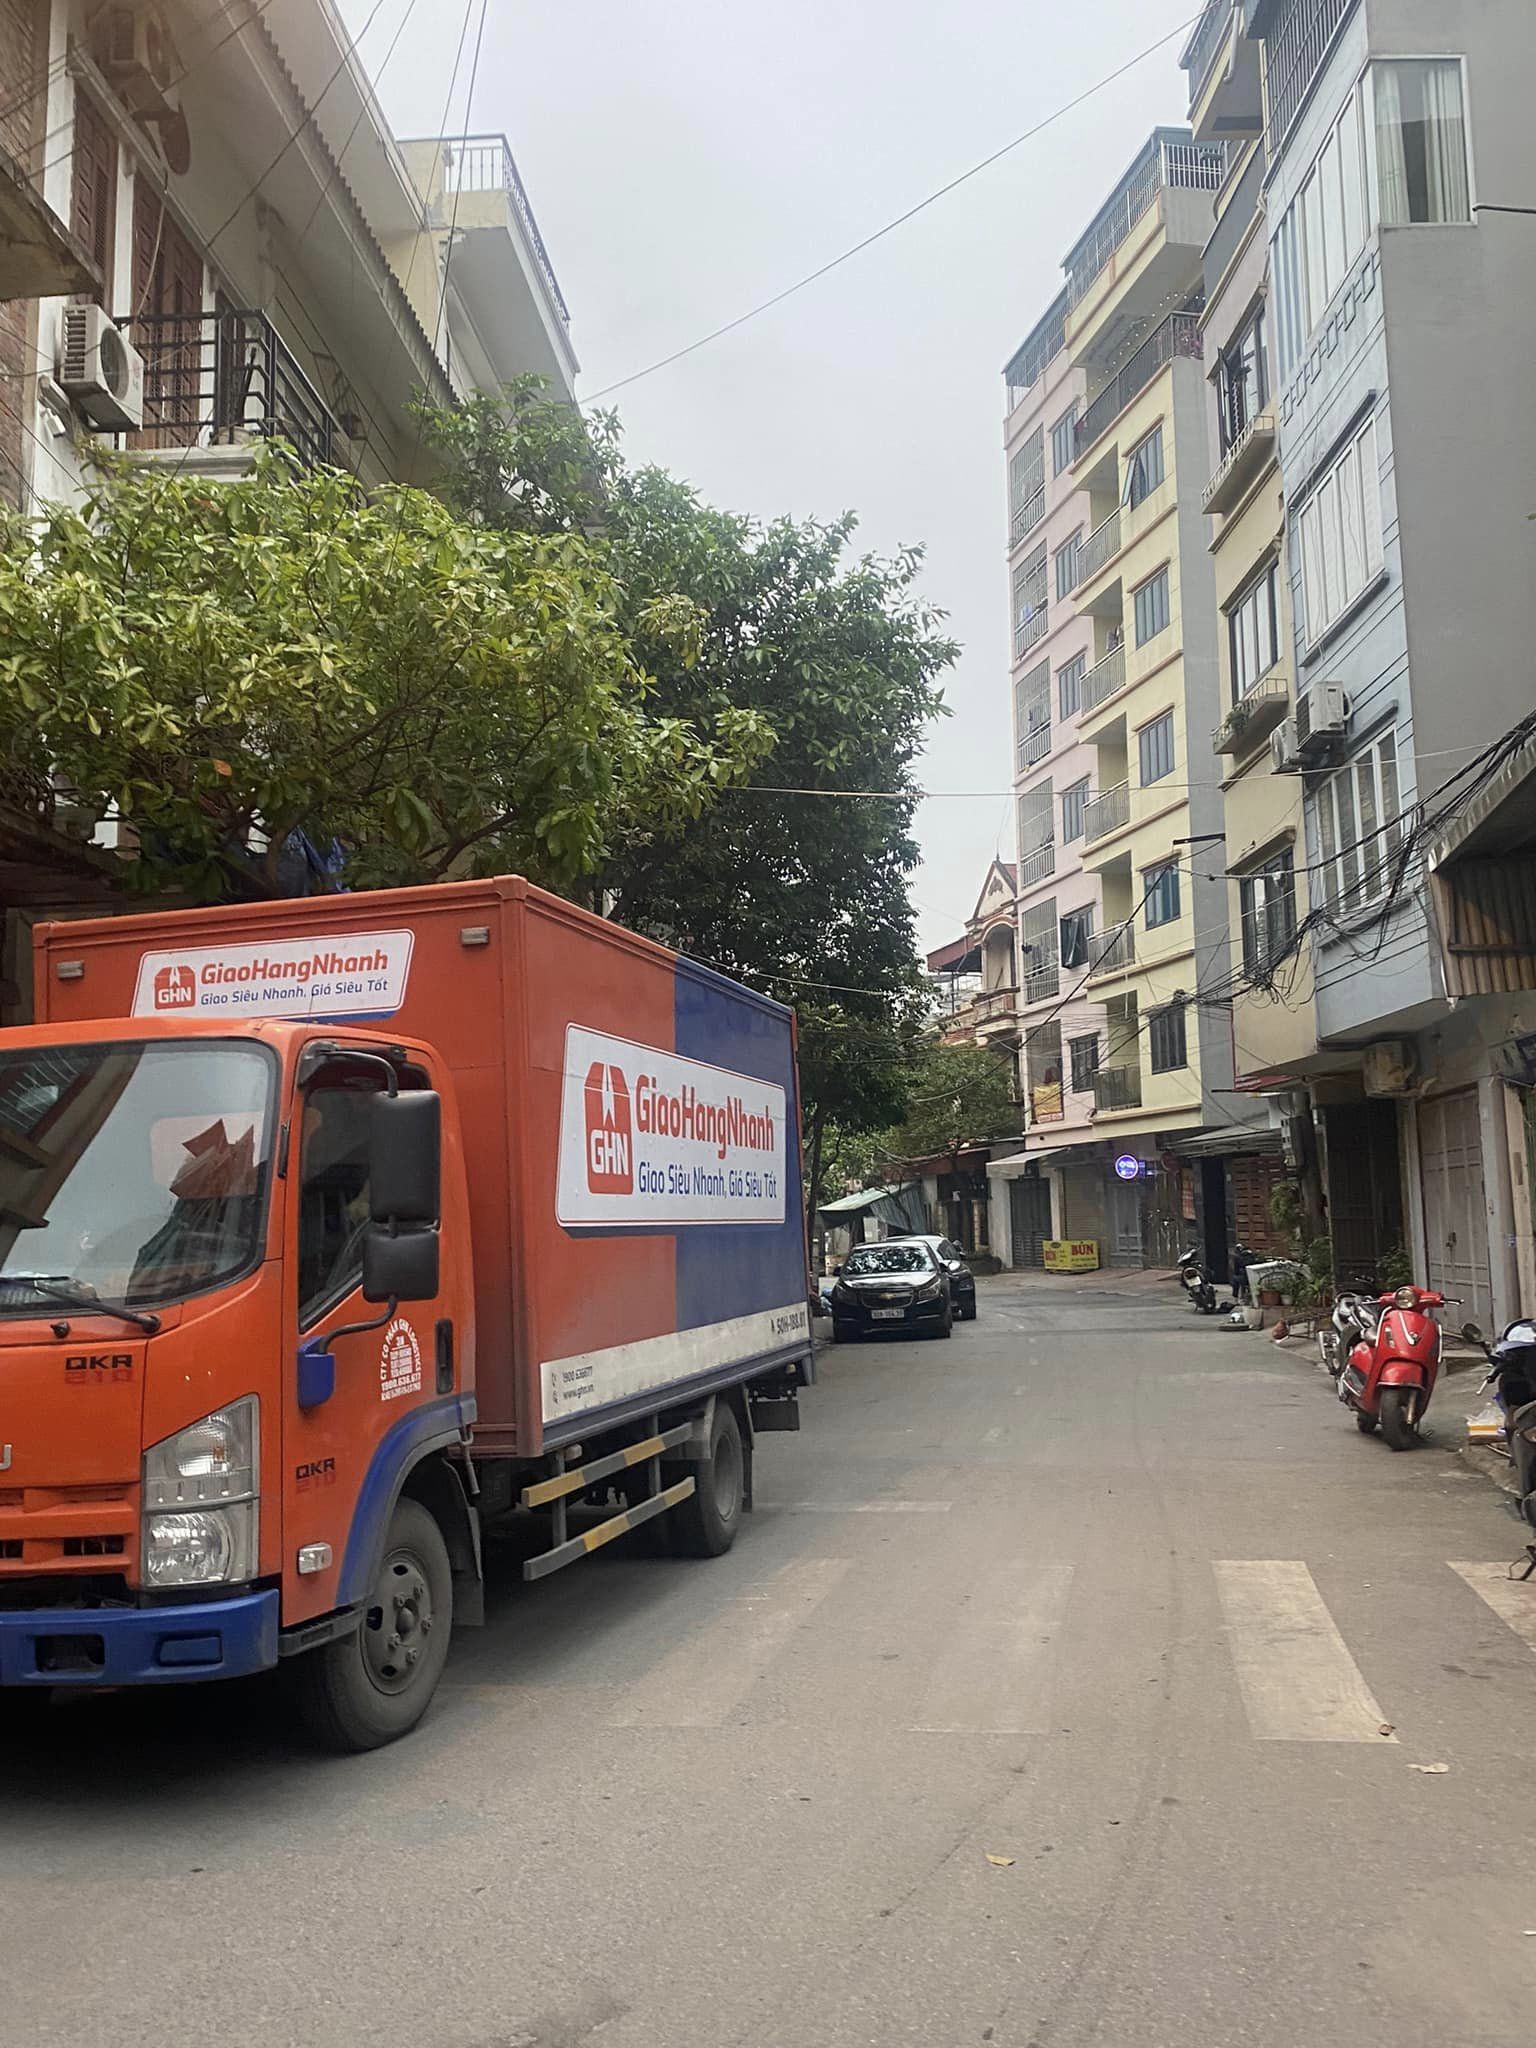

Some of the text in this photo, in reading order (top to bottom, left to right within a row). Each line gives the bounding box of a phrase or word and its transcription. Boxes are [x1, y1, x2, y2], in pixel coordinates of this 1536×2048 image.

[201, 949, 388, 984] GiaoHangNhanh
[158, 987, 192, 1003] GHN
[201, 992, 228, 1006] Giao
[232, 989, 258, 1004] Siêu
[312, 982, 331, 997] Giá
[335, 980, 362, 994] Siêu
[367, 976, 388, 992] Tốt
[636, 1074, 774, 1160] GiaoHangNhanh
[590, 1129, 629, 1176] GHN
[639, 1162, 777, 1199] Giao Siêu Nhanh, Giá Siêu Tốt
[65, 1354, 132, 1370] QKR
[296, 1457, 335, 1480] QKR
